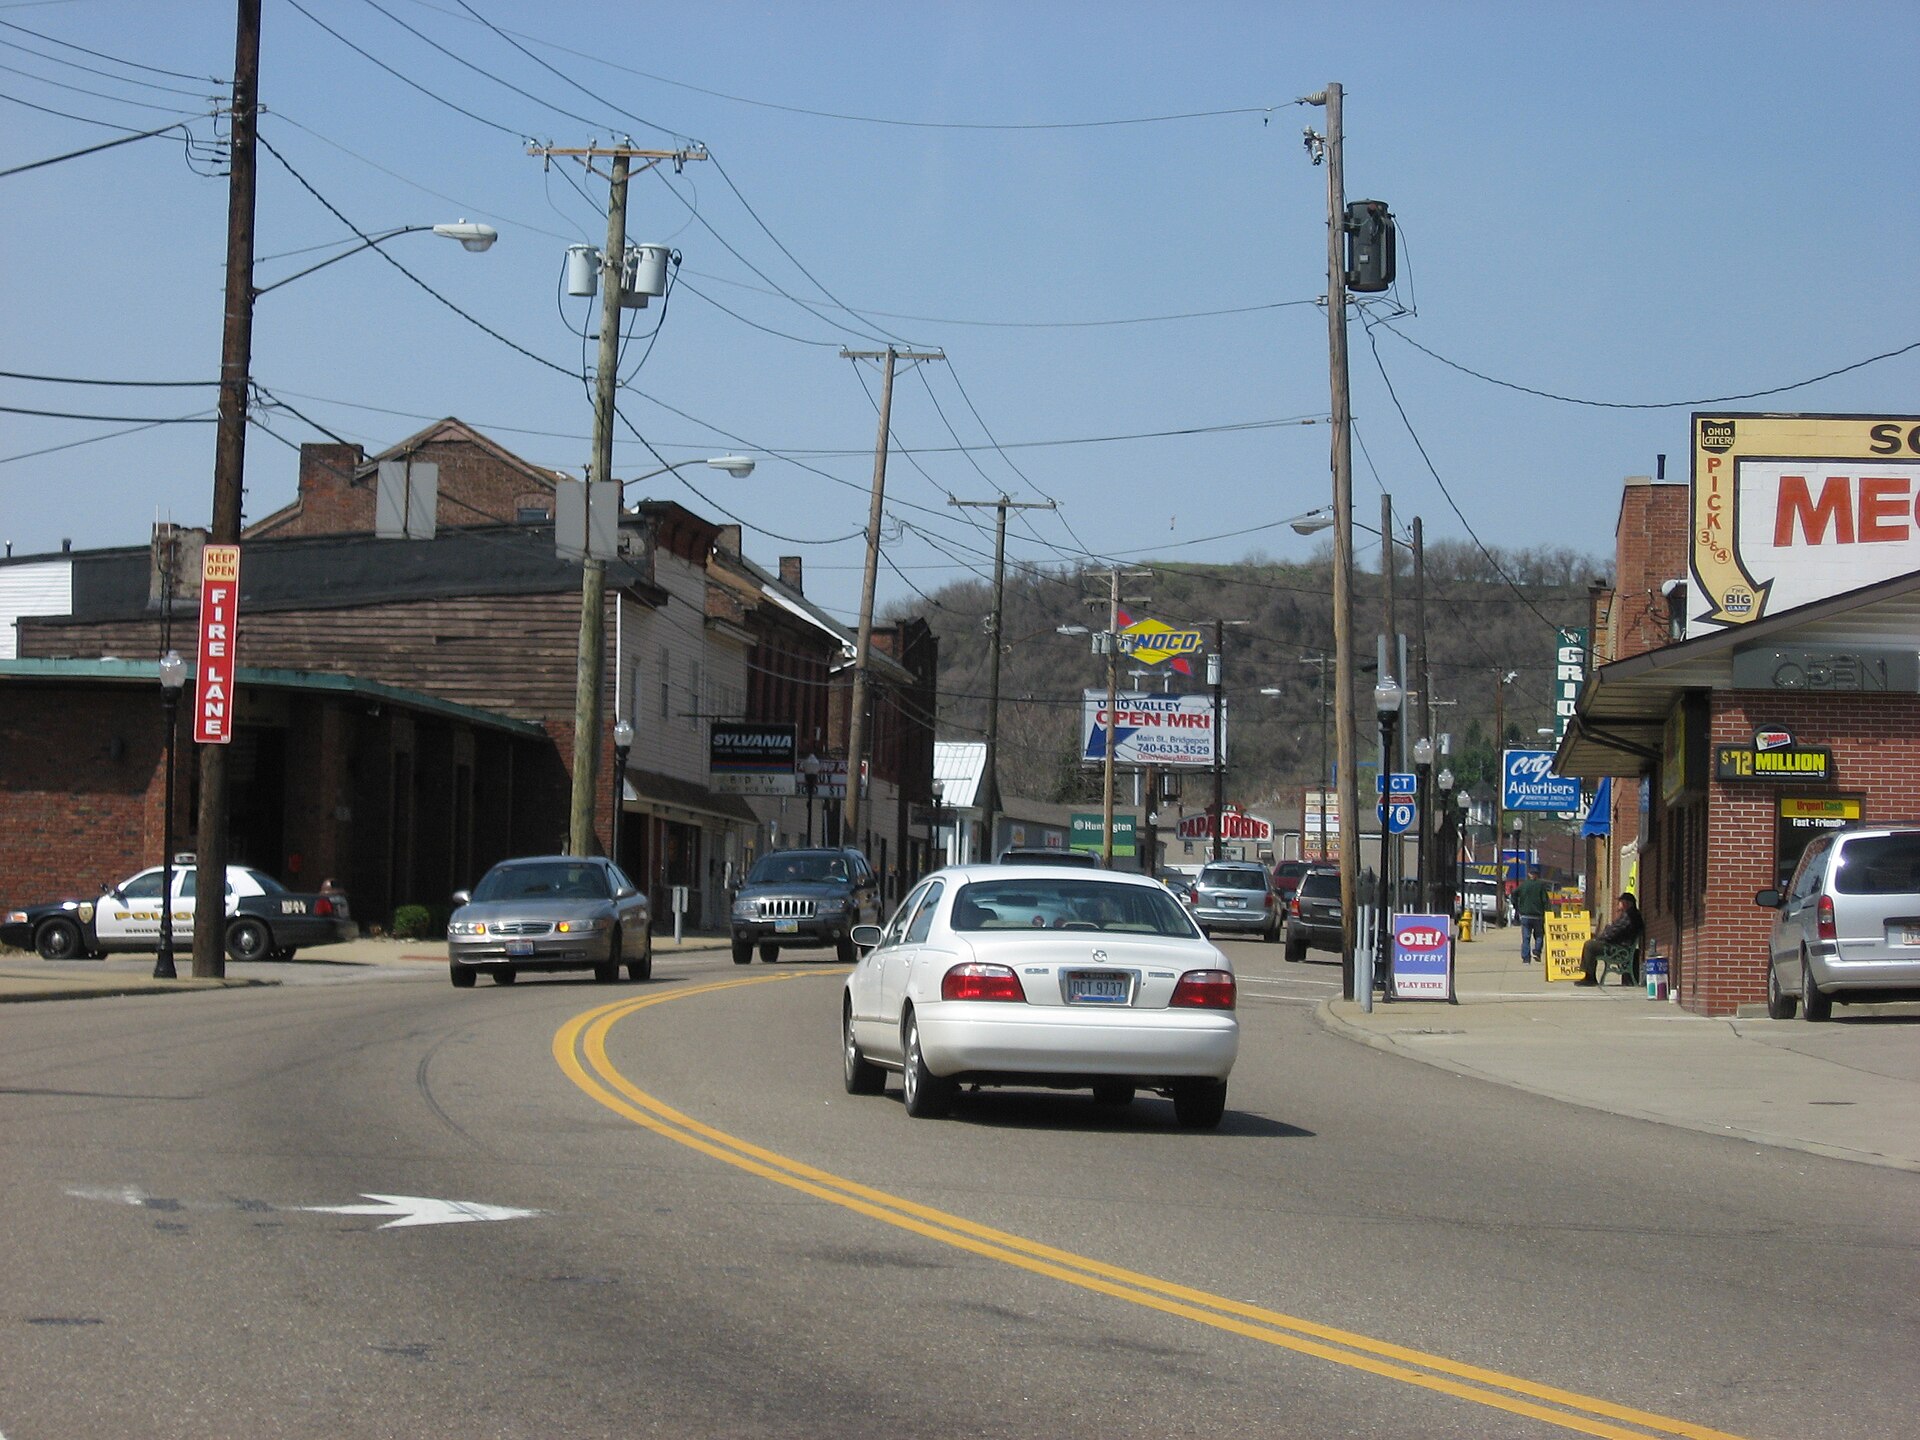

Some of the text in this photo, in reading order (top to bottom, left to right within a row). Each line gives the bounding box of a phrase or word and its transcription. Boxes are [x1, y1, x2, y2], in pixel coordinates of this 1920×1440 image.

[1707, 427, 1731, 436] OHIO
[1702, 431, 1735, 448] LOTTERY
[1707, 458, 1721, 530] PICK
[1773, 476, 1920, 548] ME
[207, 553, 235, 564] KEEP
[206, 565, 235, 577] OPEN
[1725, 594, 1751, 604] BIG
[208, 588, 227, 657] FIRE
[1121, 633, 1198, 650] NOCO
[205, 667, 225, 735] LANE
[1097, 701, 1182, 712] OIO VALLEY
[1167, 713, 1211, 729] MRI
[713, 734, 793, 748] SYLVANIA
[1136, 734, 1155, 742] Main
[1169, 736, 1210, 745] Bridgeport
[1137, 743, 1210, 755] 740-633-3529
[1755, 753, 1825, 771] MILLION
[1381, 778, 1410, 790] CT
[1508, 781, 1574, 795] Advertisers
[1084, 821, 1132, 833] Huntgton
[1180, 816, 1217, 838] PAPA
[1792, 818, 1847, 828] Fast Friendly
[1548, 924, 1568, 932] TUES
[1399, 931, 1442, 946] OH!
[1551, 932, 1586, 941] TWOFERS
[1554, 958, 1581, 966] HAPPY
[1397, 981, 1419, 989] PLAY
